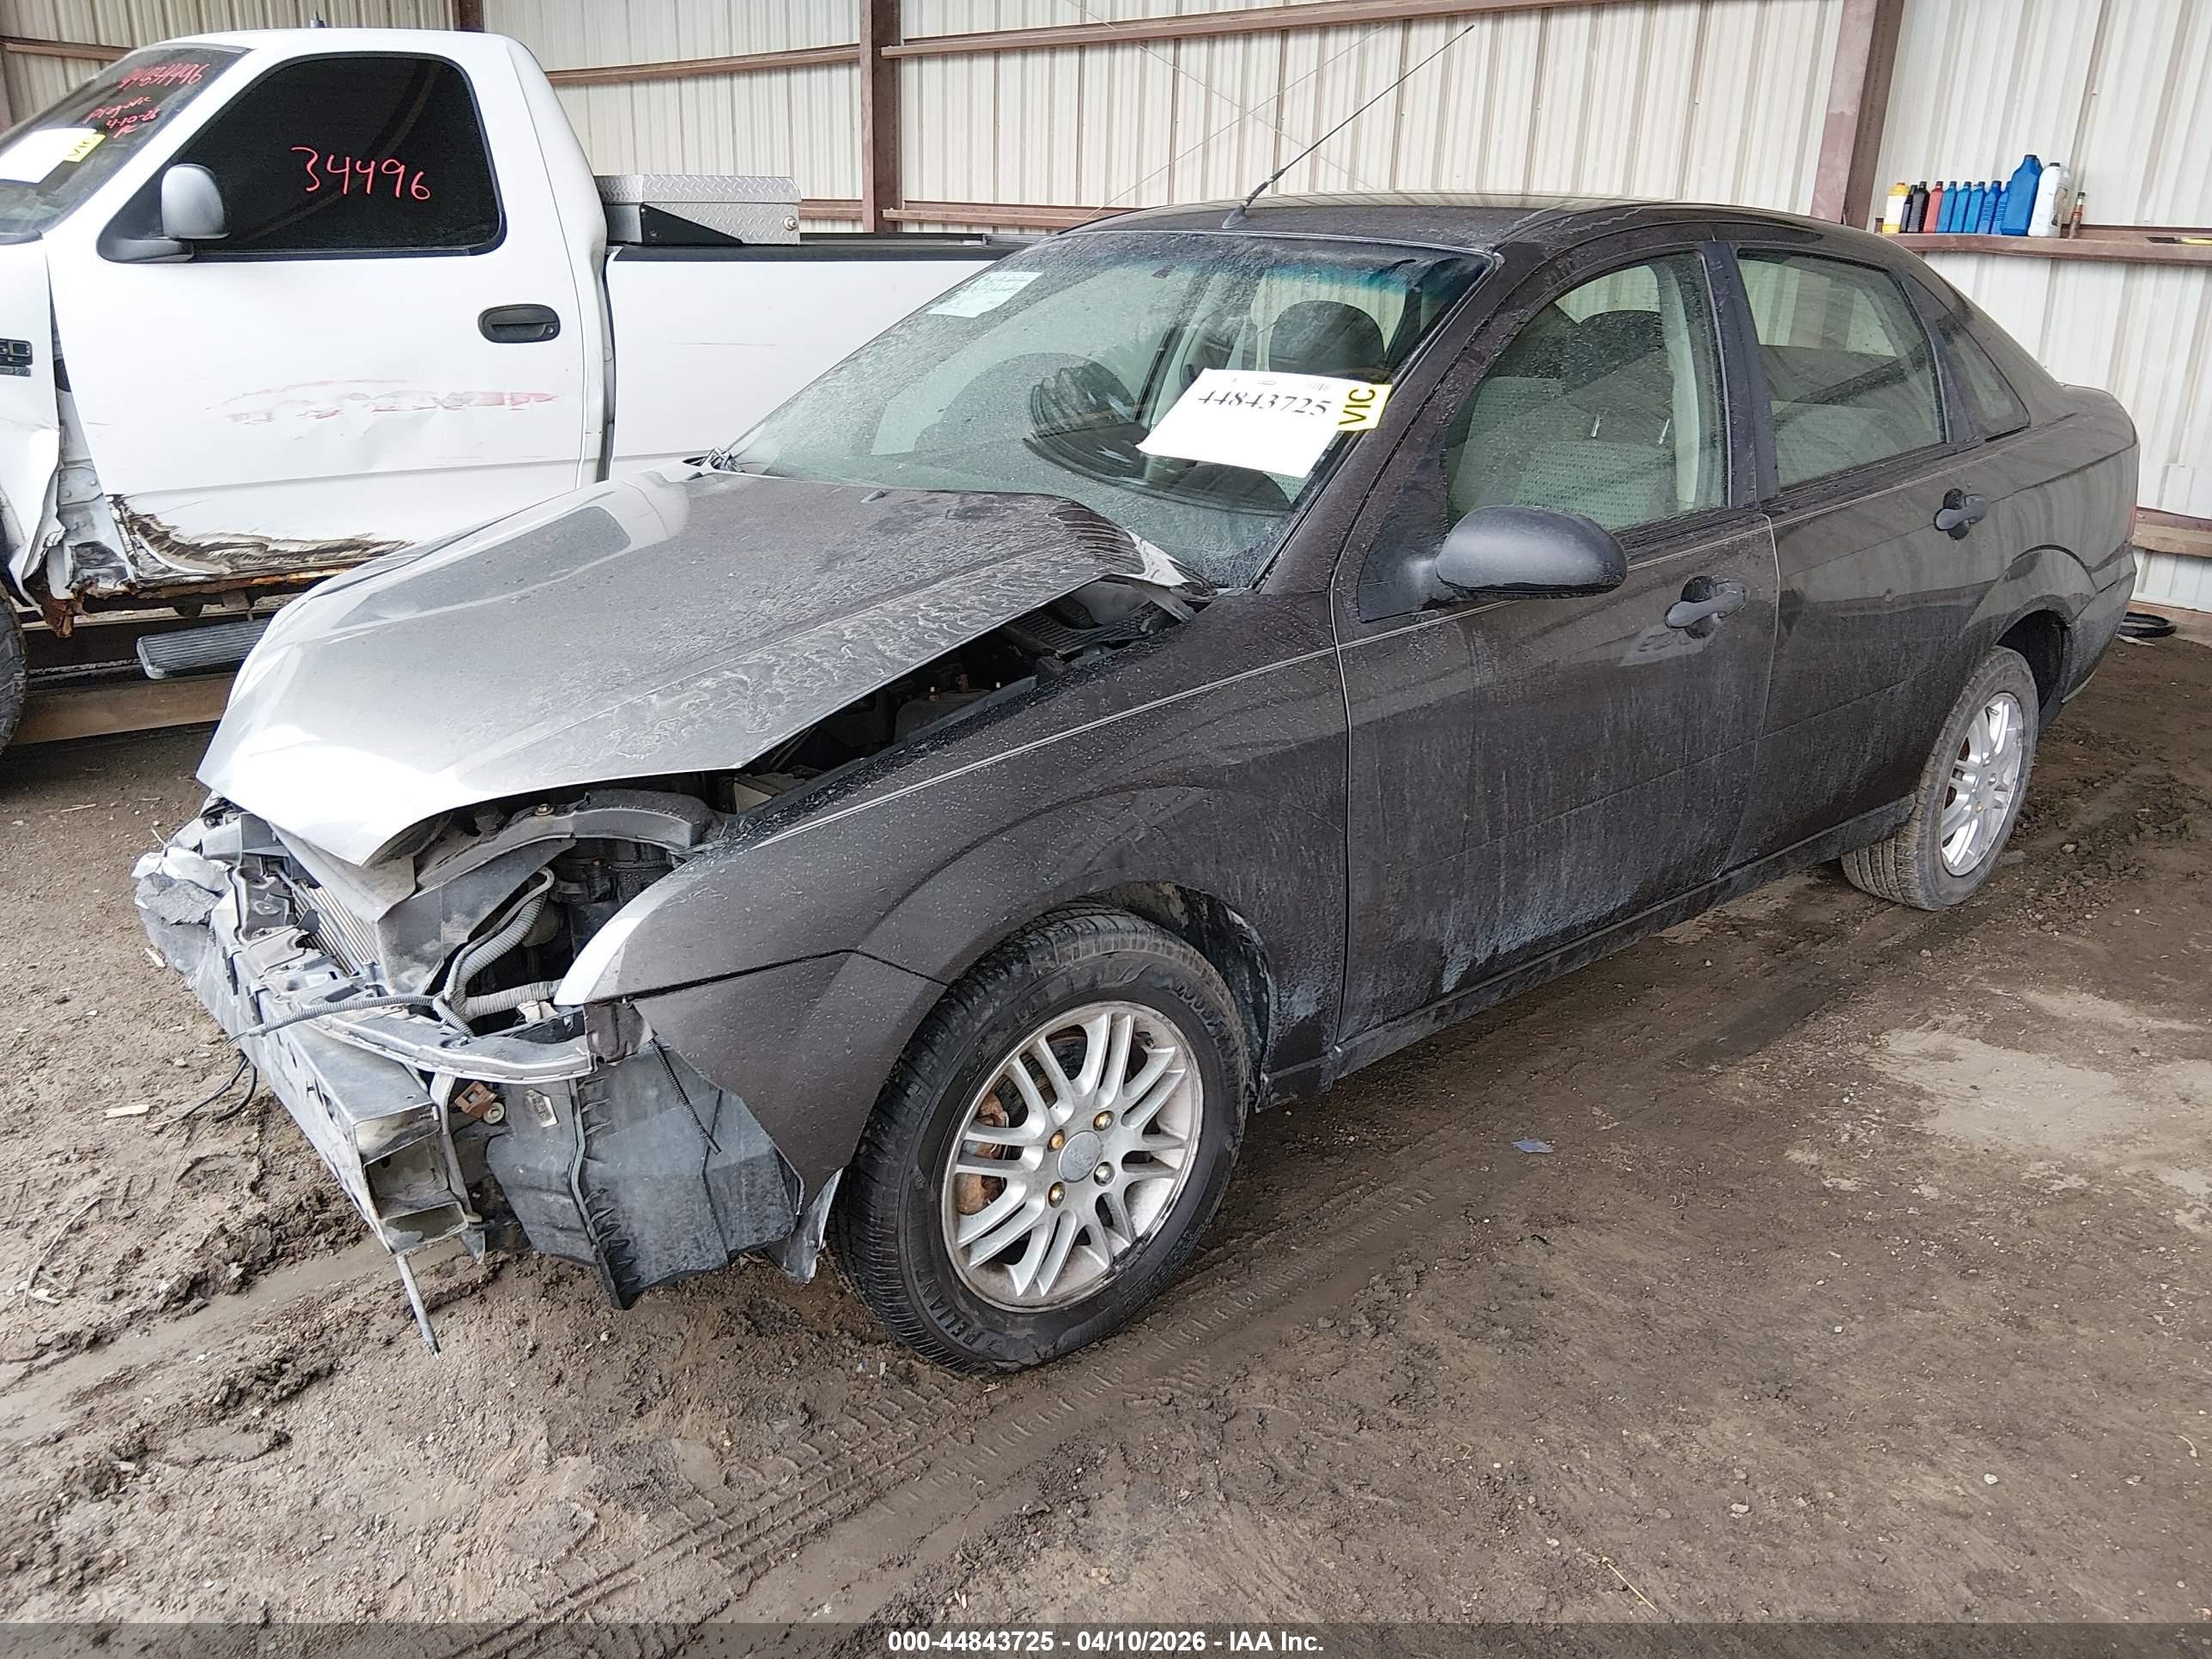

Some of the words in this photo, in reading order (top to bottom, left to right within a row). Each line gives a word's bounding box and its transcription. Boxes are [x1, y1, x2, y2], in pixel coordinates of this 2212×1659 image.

[290, 146, 431, 200] 34496
[1198, 389, 1332, 416] 44843725
[1338, 388, 1376, 426] VIC
